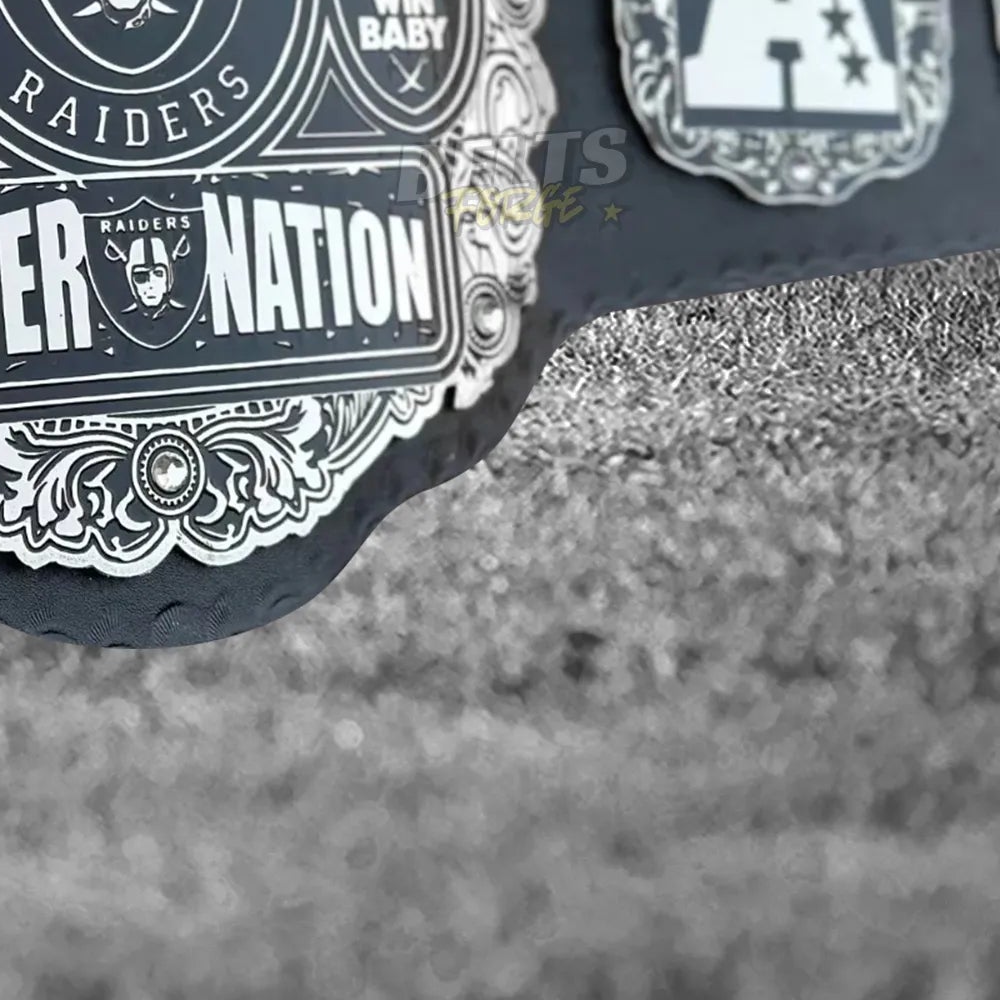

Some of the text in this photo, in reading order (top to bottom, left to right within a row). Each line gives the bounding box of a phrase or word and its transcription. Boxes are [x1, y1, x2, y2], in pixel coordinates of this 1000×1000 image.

[358, 16, 448, 50] BABY
[9, 64, 249, 147] RAIDERS
[100, 215, 191, 234] RAIDERS
[201, 191, 432, 336] NATION
